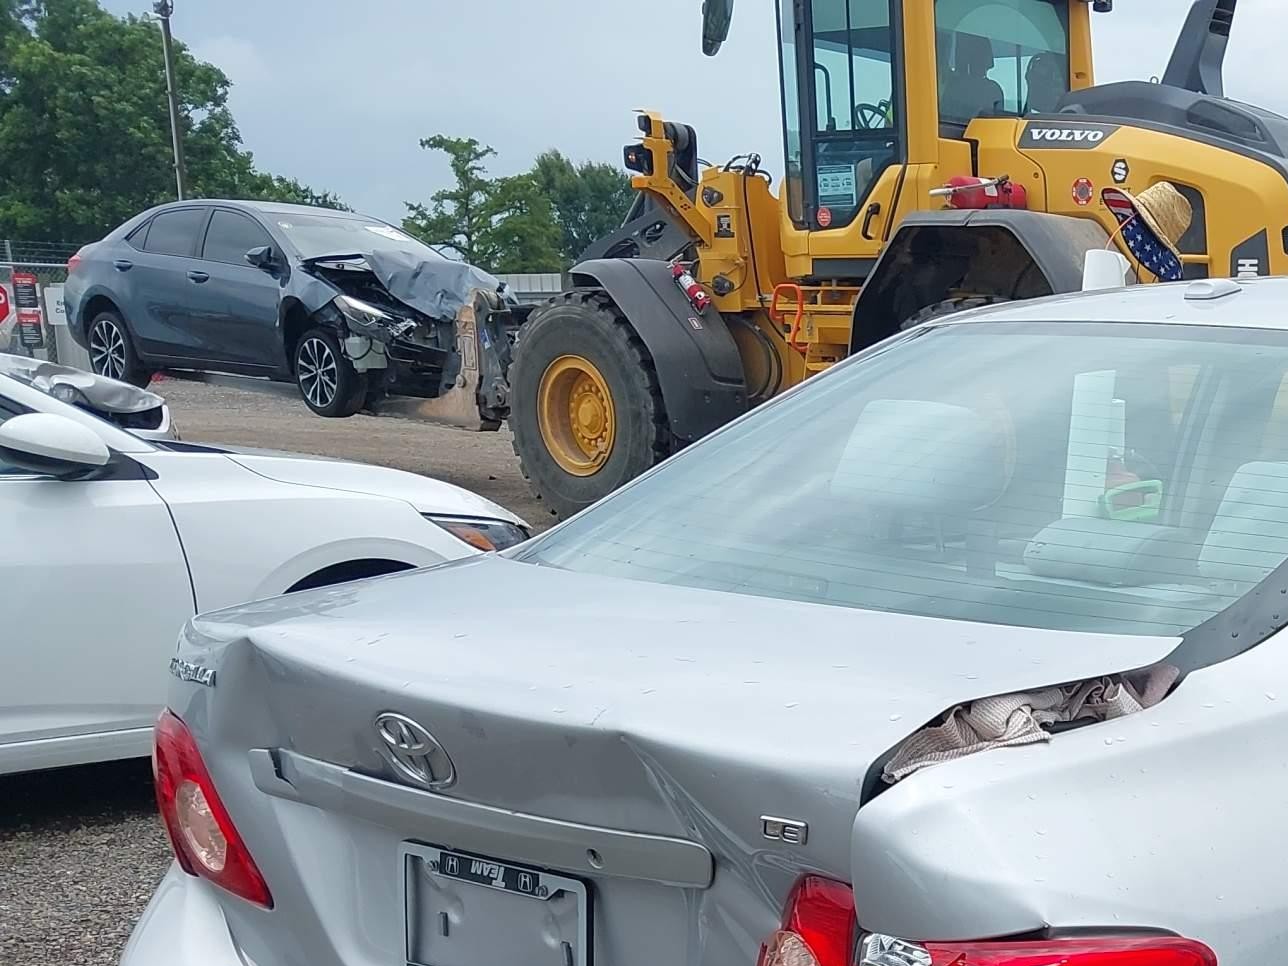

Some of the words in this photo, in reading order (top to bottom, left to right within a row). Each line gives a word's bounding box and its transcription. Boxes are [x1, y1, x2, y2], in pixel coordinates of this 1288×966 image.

[1030, 128, 1104, 141] VOLVO
[760, 814, 808, 846] LE
[470, 860, 506, 888] TEAM
